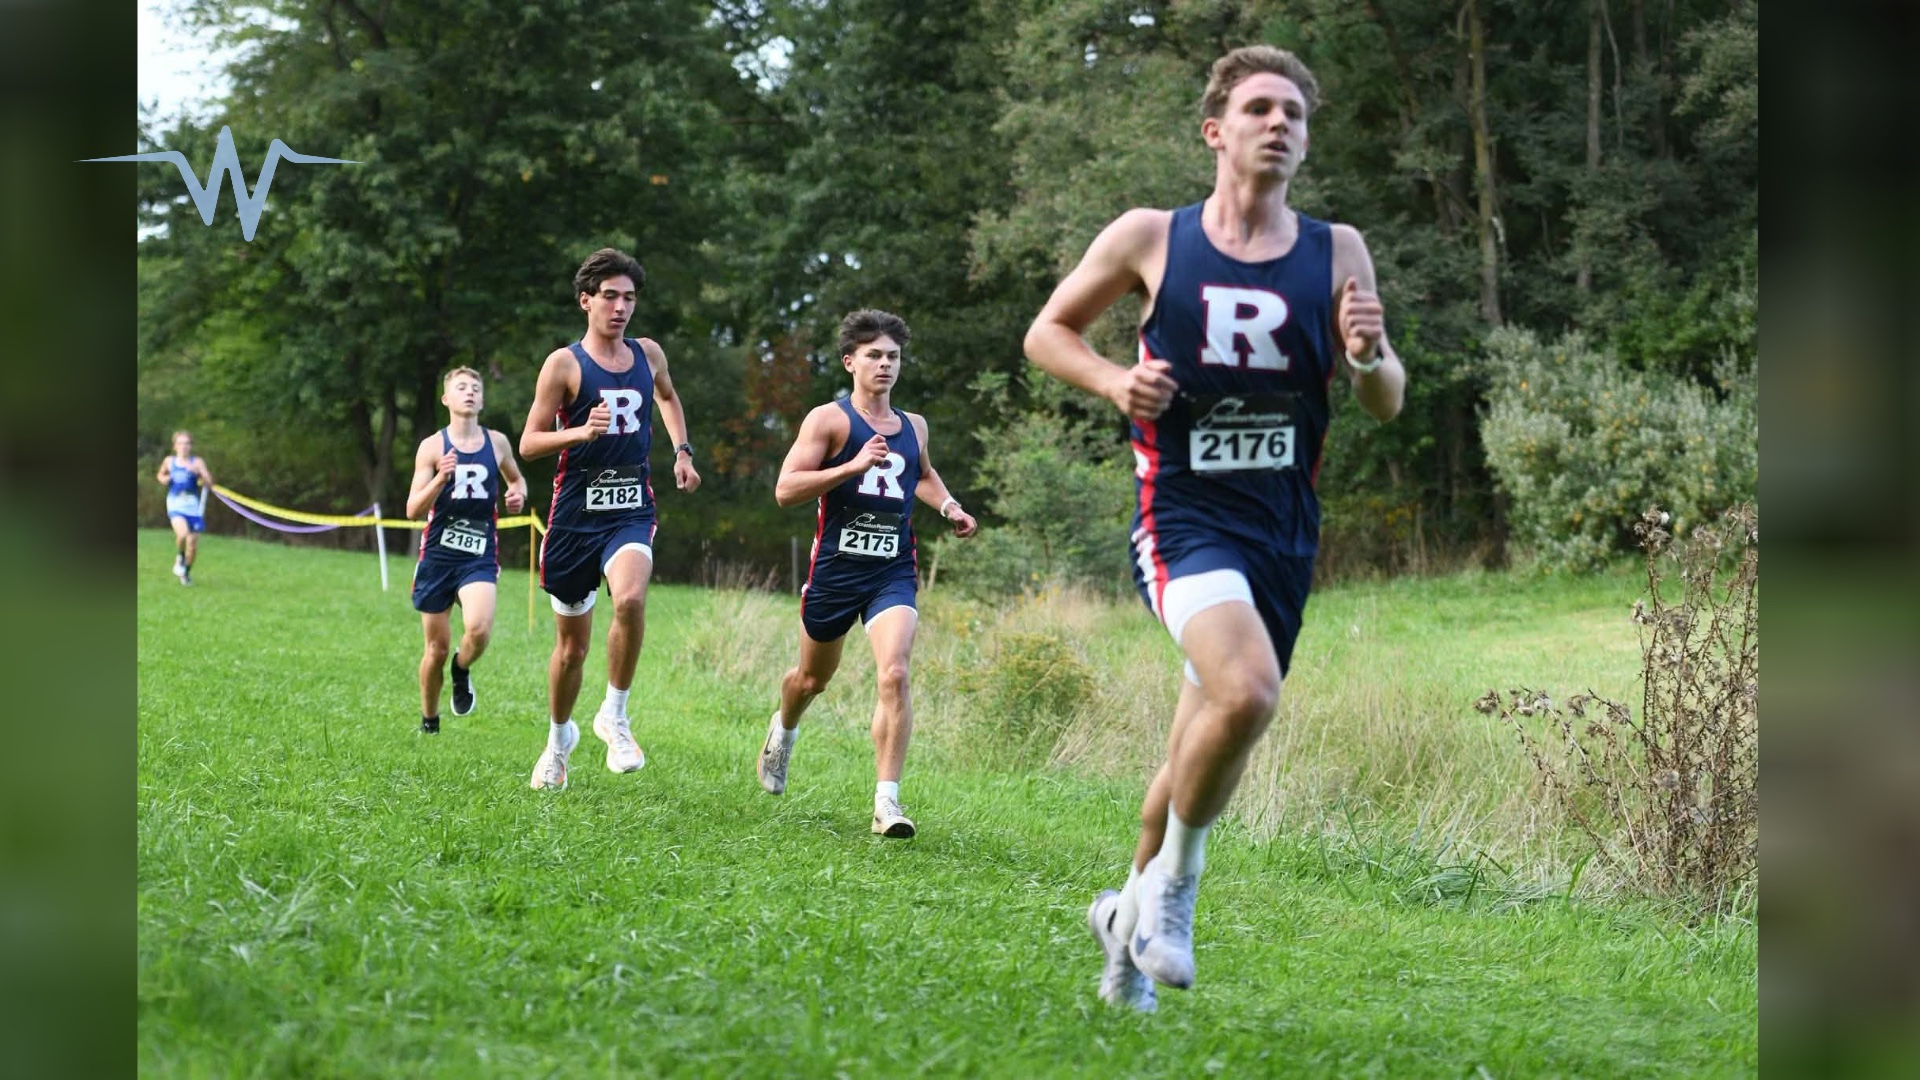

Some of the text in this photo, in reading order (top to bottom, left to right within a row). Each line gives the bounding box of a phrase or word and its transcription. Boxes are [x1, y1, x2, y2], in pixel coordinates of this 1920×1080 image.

[1201, 284, 1289, 370] R
[599, 389, 642, 434] R
[1199, 431, 1286, 461] 2176
[451, 464, 488, 499] R
[858, 452, 905, 499] R
[591, 487, 638, 505] 2182
[445, 531, 481, 550] 2181
[845, 531, 894, 553] 2175
